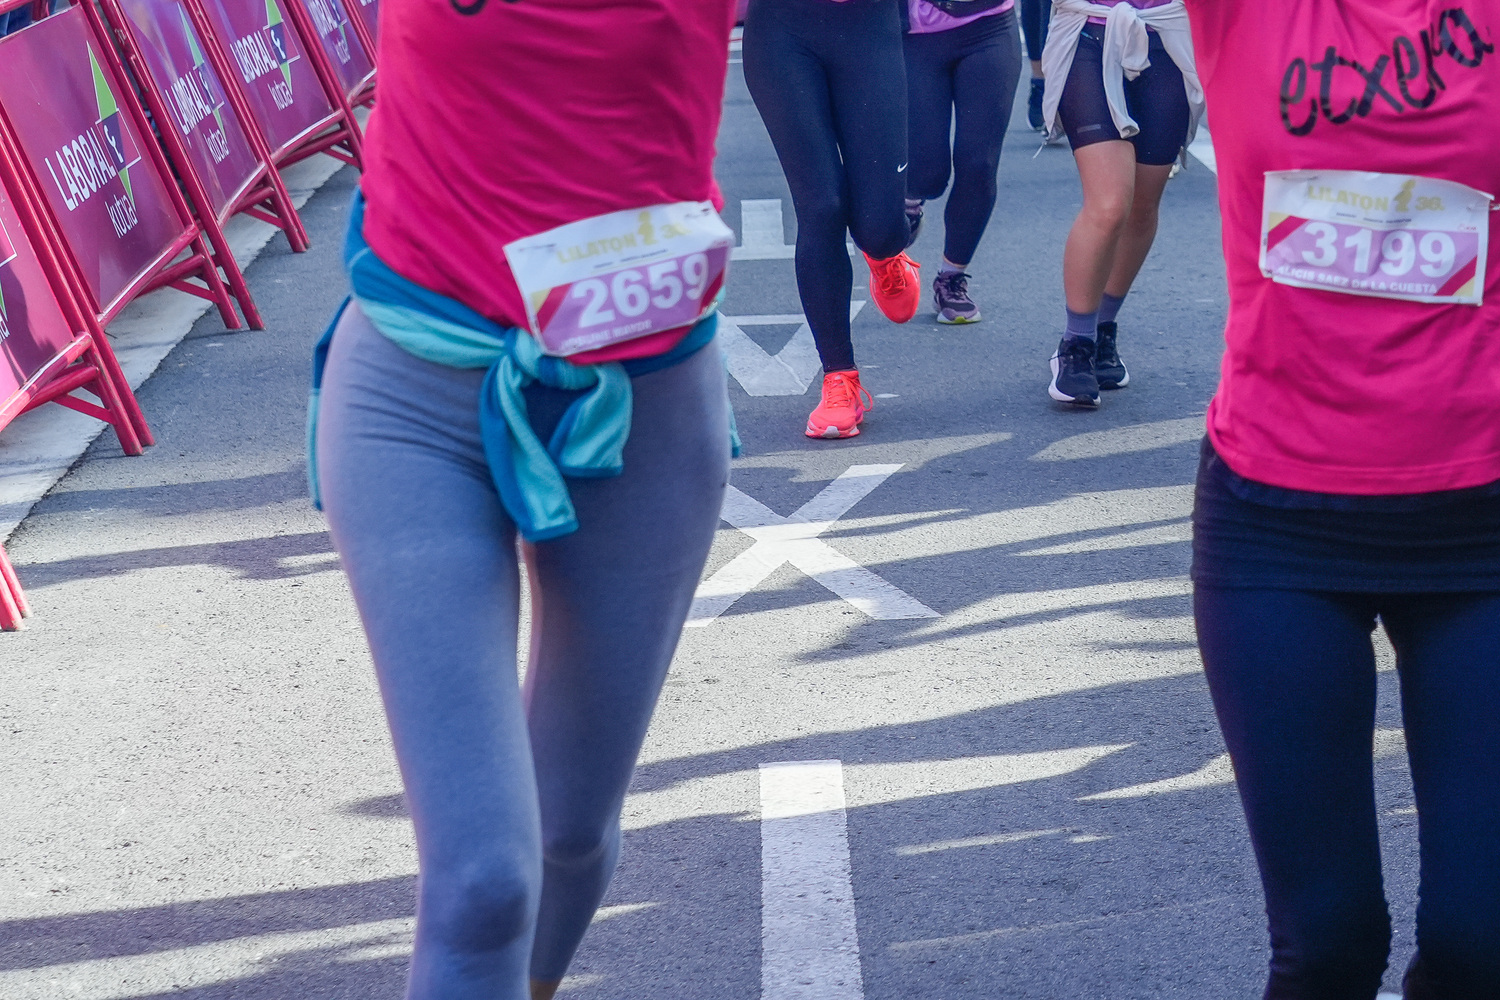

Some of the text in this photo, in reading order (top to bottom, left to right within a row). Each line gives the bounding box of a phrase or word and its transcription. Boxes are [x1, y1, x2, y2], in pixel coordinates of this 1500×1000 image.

[229, 29, 279, 84] LABORAL
[1278, 7, 1495, 137] etxera
[44, 126, 116, 212] LABORAL
[104, 193, 138, 239] kutxa
[1307, 185, 1389, 213] LILATON
[556, 231, 638, 265] LILATON
[1300, 221, 1457, 278] 3199
[571, 252, 710, 329] 2659
[1370, 280, 1387, 290] LA
